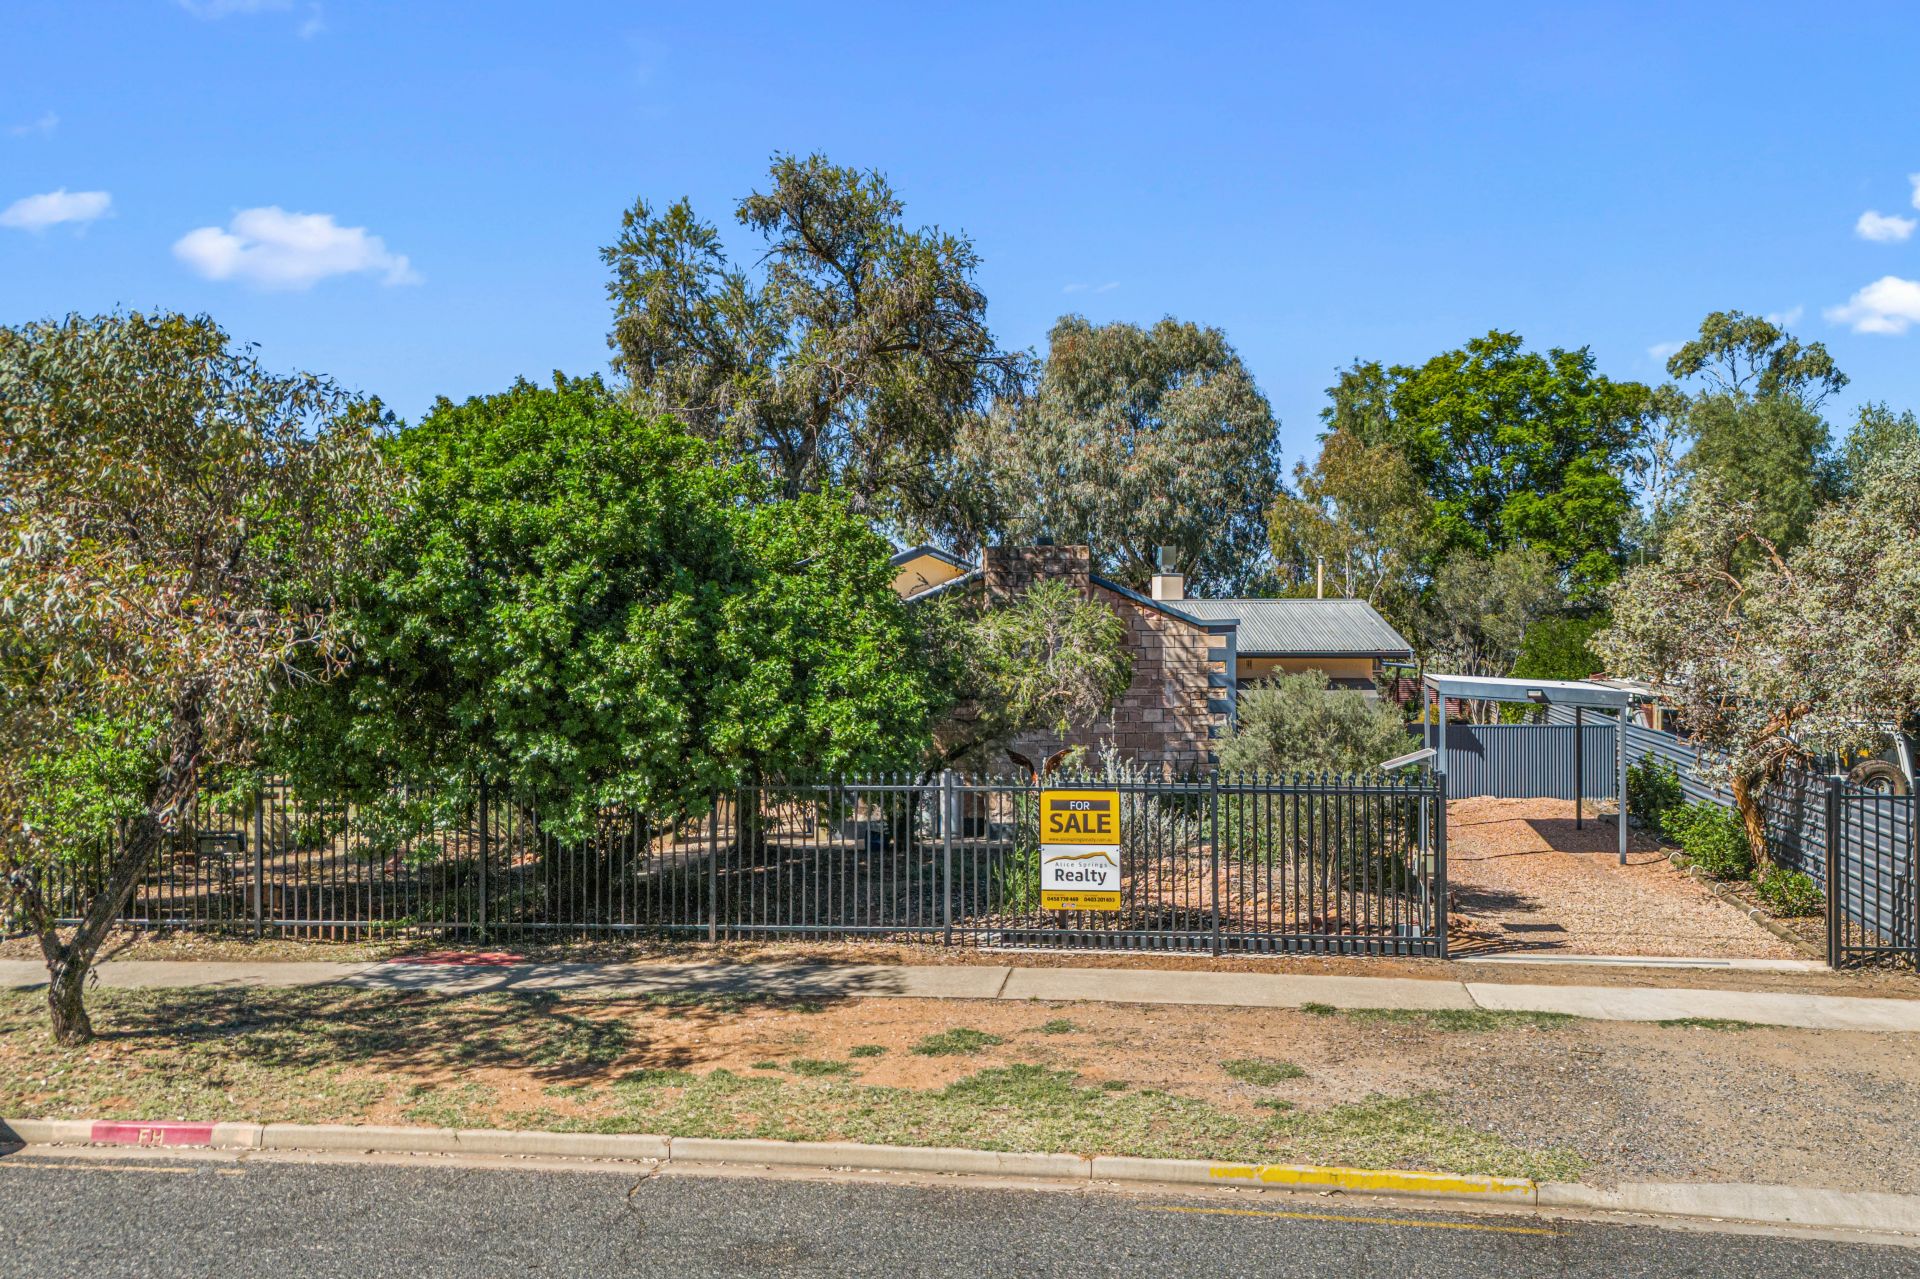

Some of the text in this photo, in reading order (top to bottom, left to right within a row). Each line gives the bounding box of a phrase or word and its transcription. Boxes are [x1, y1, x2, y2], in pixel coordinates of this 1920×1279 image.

[1070, 801, 1090, 811] FOR
[1050, 813, 1111, 833] SALE
[1055, 868, 1107, 886] Realty
[138, 1129, 164, 1145] FH
